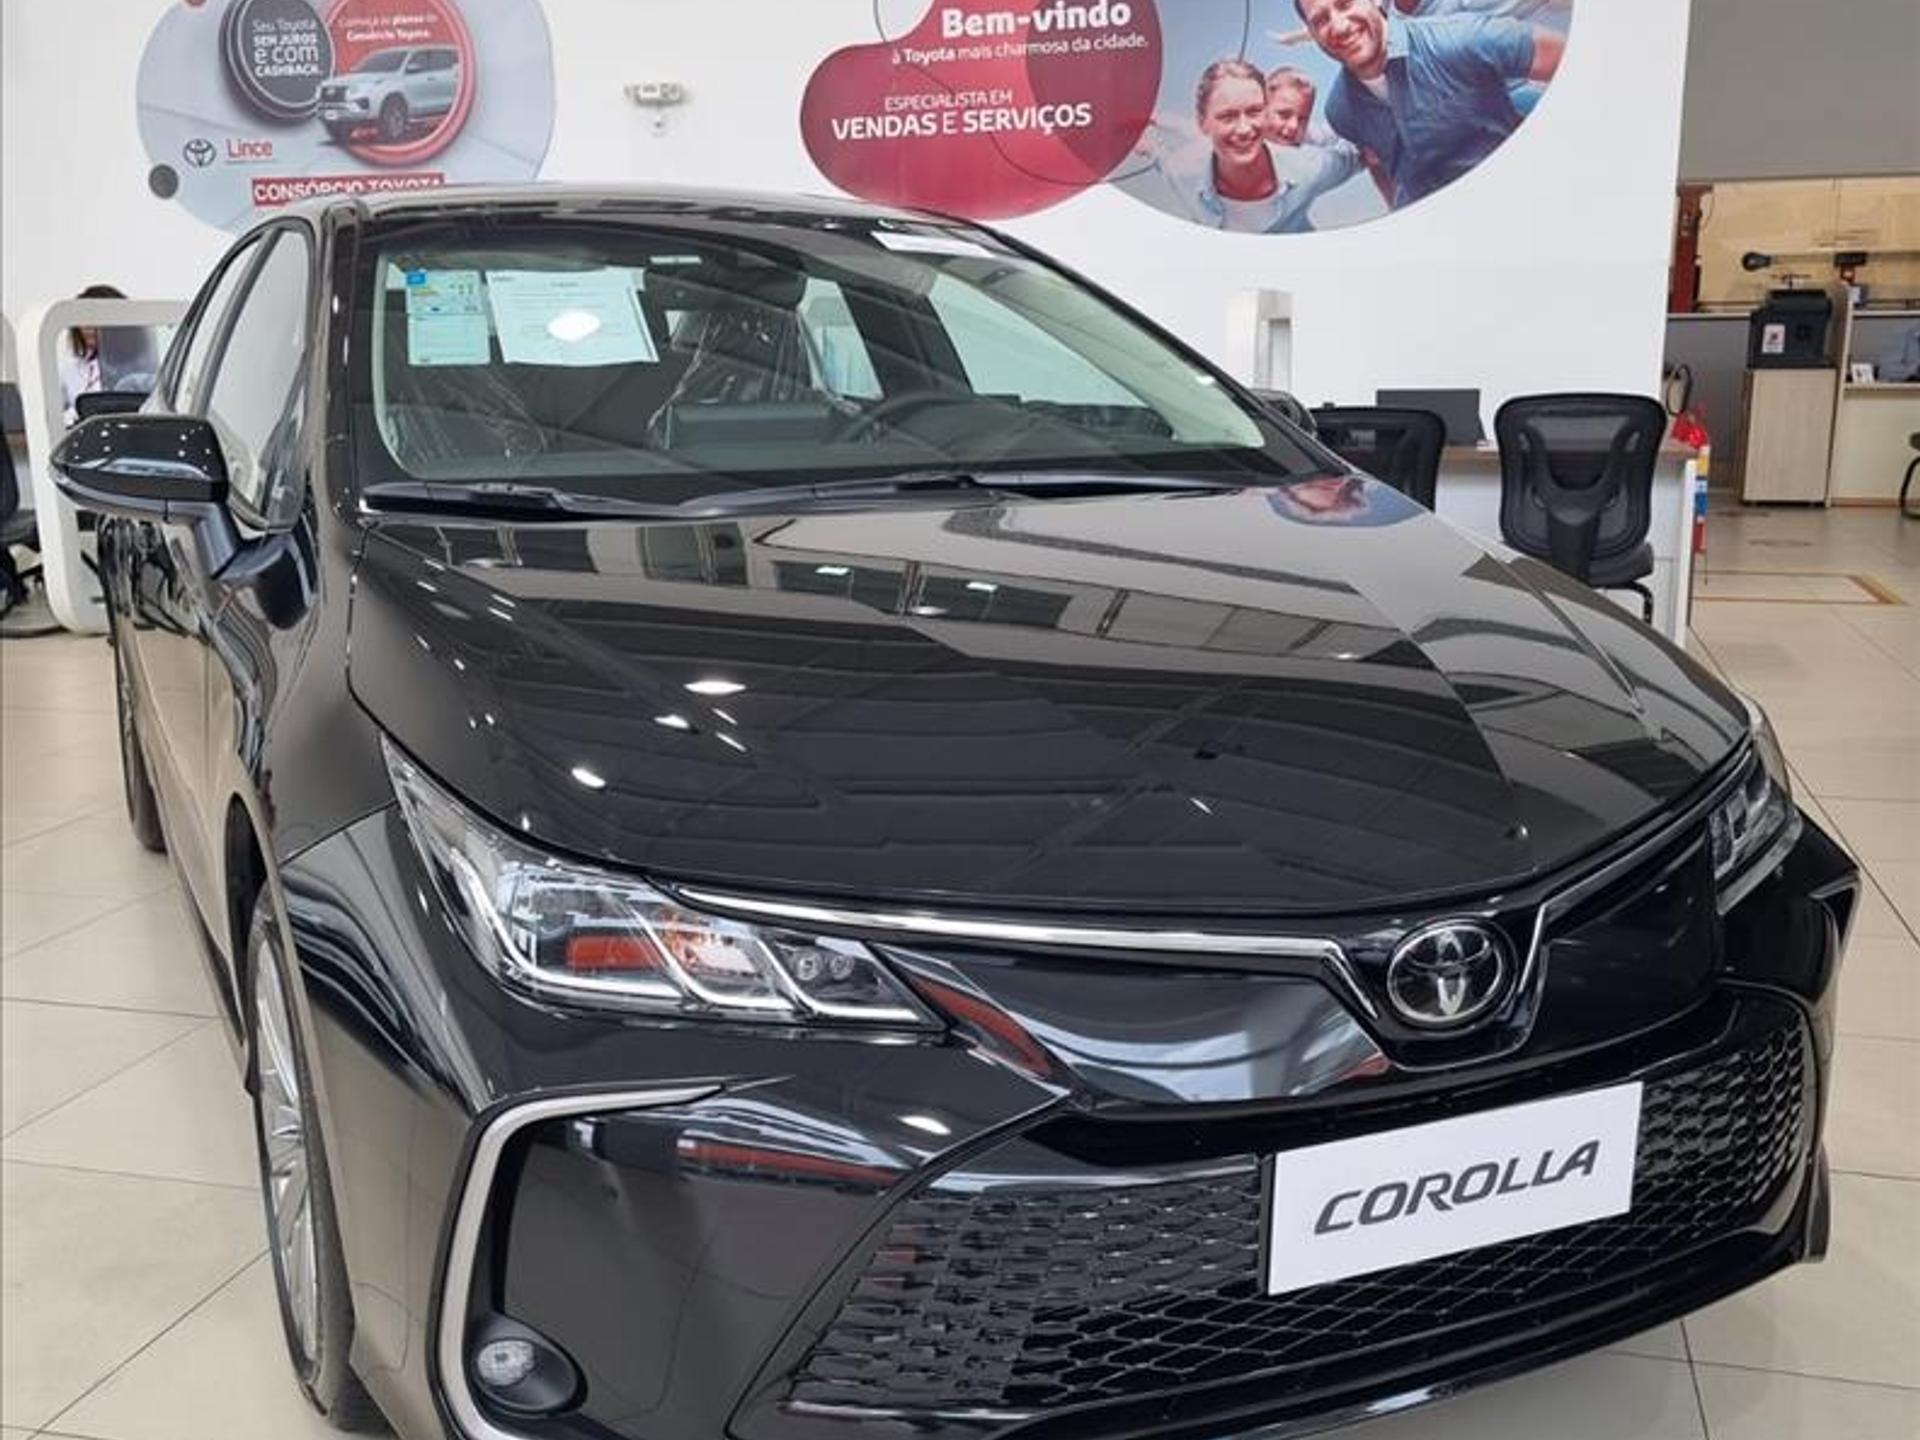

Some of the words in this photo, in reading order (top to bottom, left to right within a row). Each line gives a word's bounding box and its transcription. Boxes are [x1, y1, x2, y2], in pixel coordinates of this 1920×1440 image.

[942, 1, 1131, 38] Bem-vindo
[254, 48, 267, 64] e
[272, 46, 319, 63] com
[904, 47, 956, 65] Toyota
[958, 45, 993, 58] mais
[994, 40, 1069, 57] charmosa
[1072, 37, 1091, 51] da
[1093, 32, 1149, 49] cidade.
[884, 92, 988, 111] ESPECIALISTA
[990, 89, 1013, 104] EM
[832, 113, 937, 140] VENDAS
[943, 111, 955, 134] E
[962, 103, 1092, 135] SERVIÇOS
[225, 139, 273, 157] Lince
[1314, 1140, 1600, 1235] COROLLA
